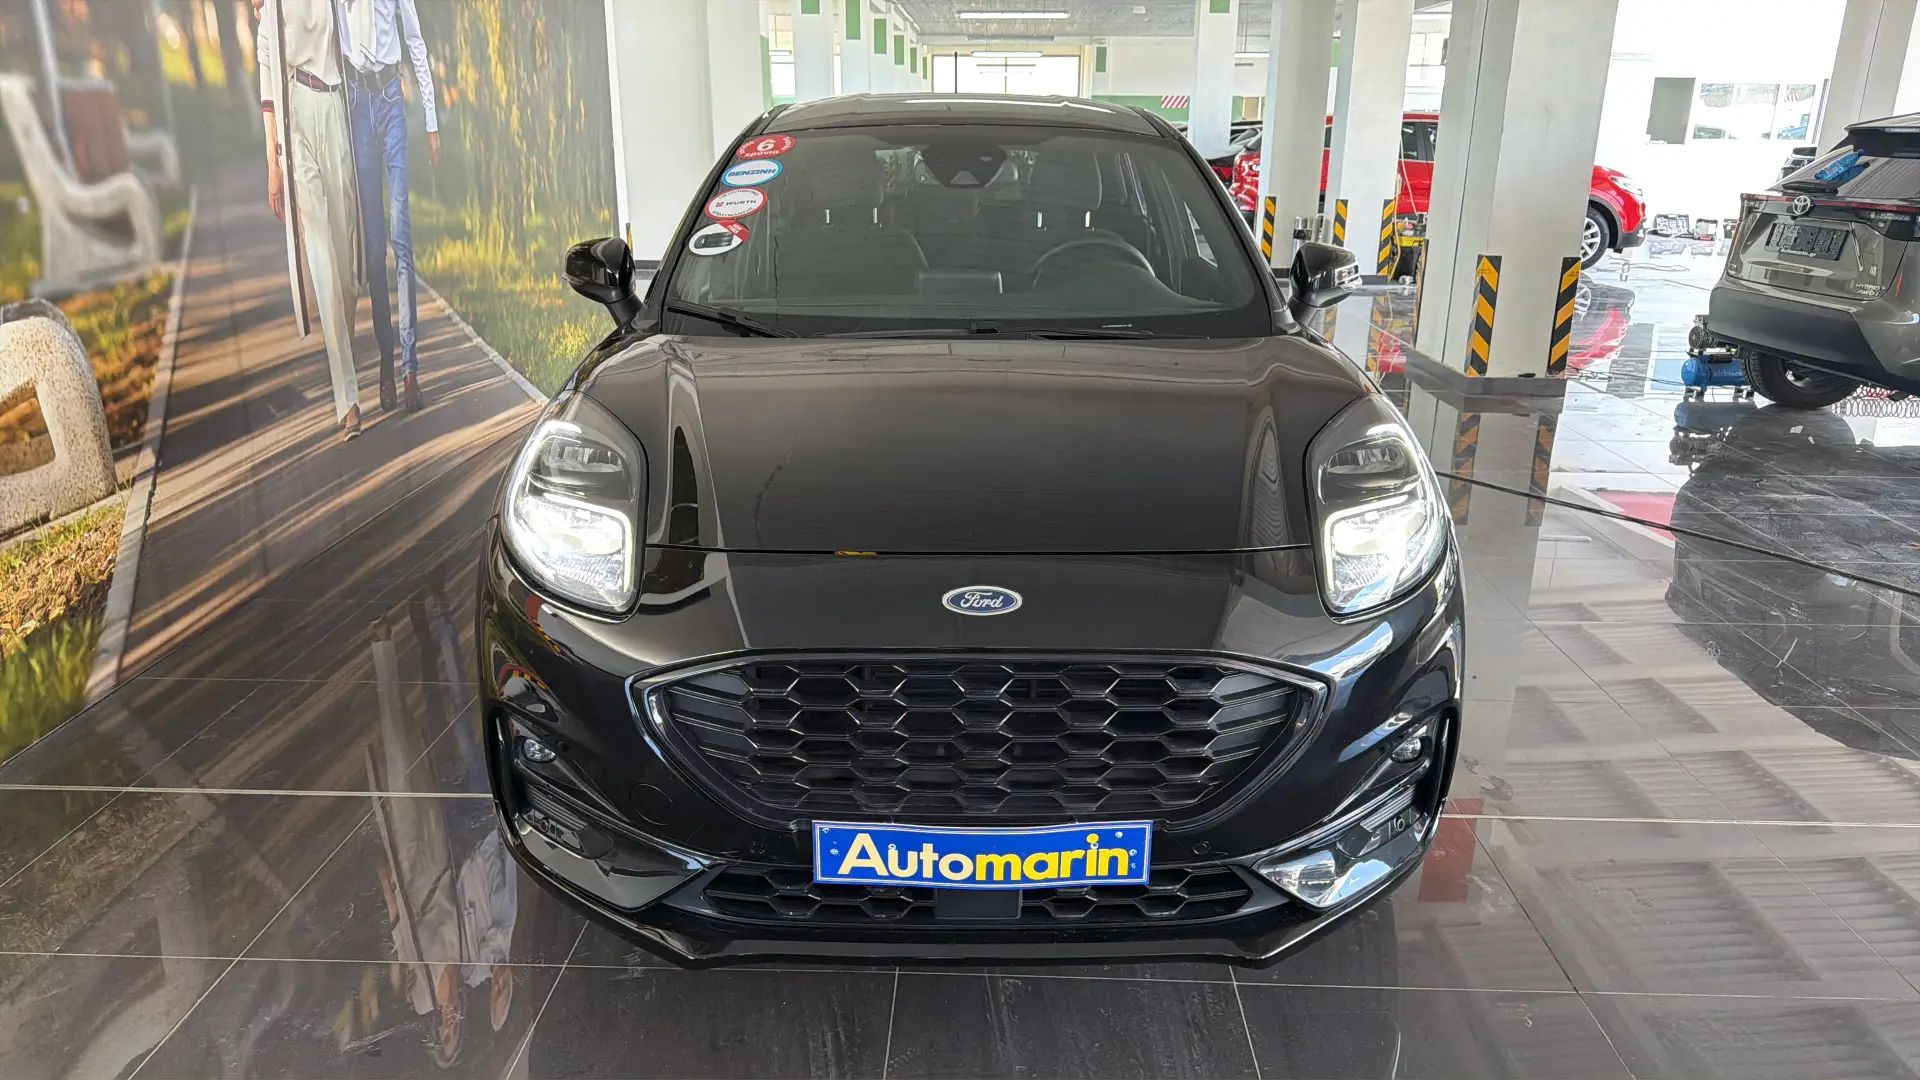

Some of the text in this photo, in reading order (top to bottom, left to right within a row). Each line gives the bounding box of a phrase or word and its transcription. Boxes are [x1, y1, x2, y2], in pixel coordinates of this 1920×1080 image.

[756, 139, 777, 151] 6
[1856, 283, 1880, 291] HYBRID
[960, 591, 1004, 608] Ford
[837, 833, 1129, 881] Automarin
